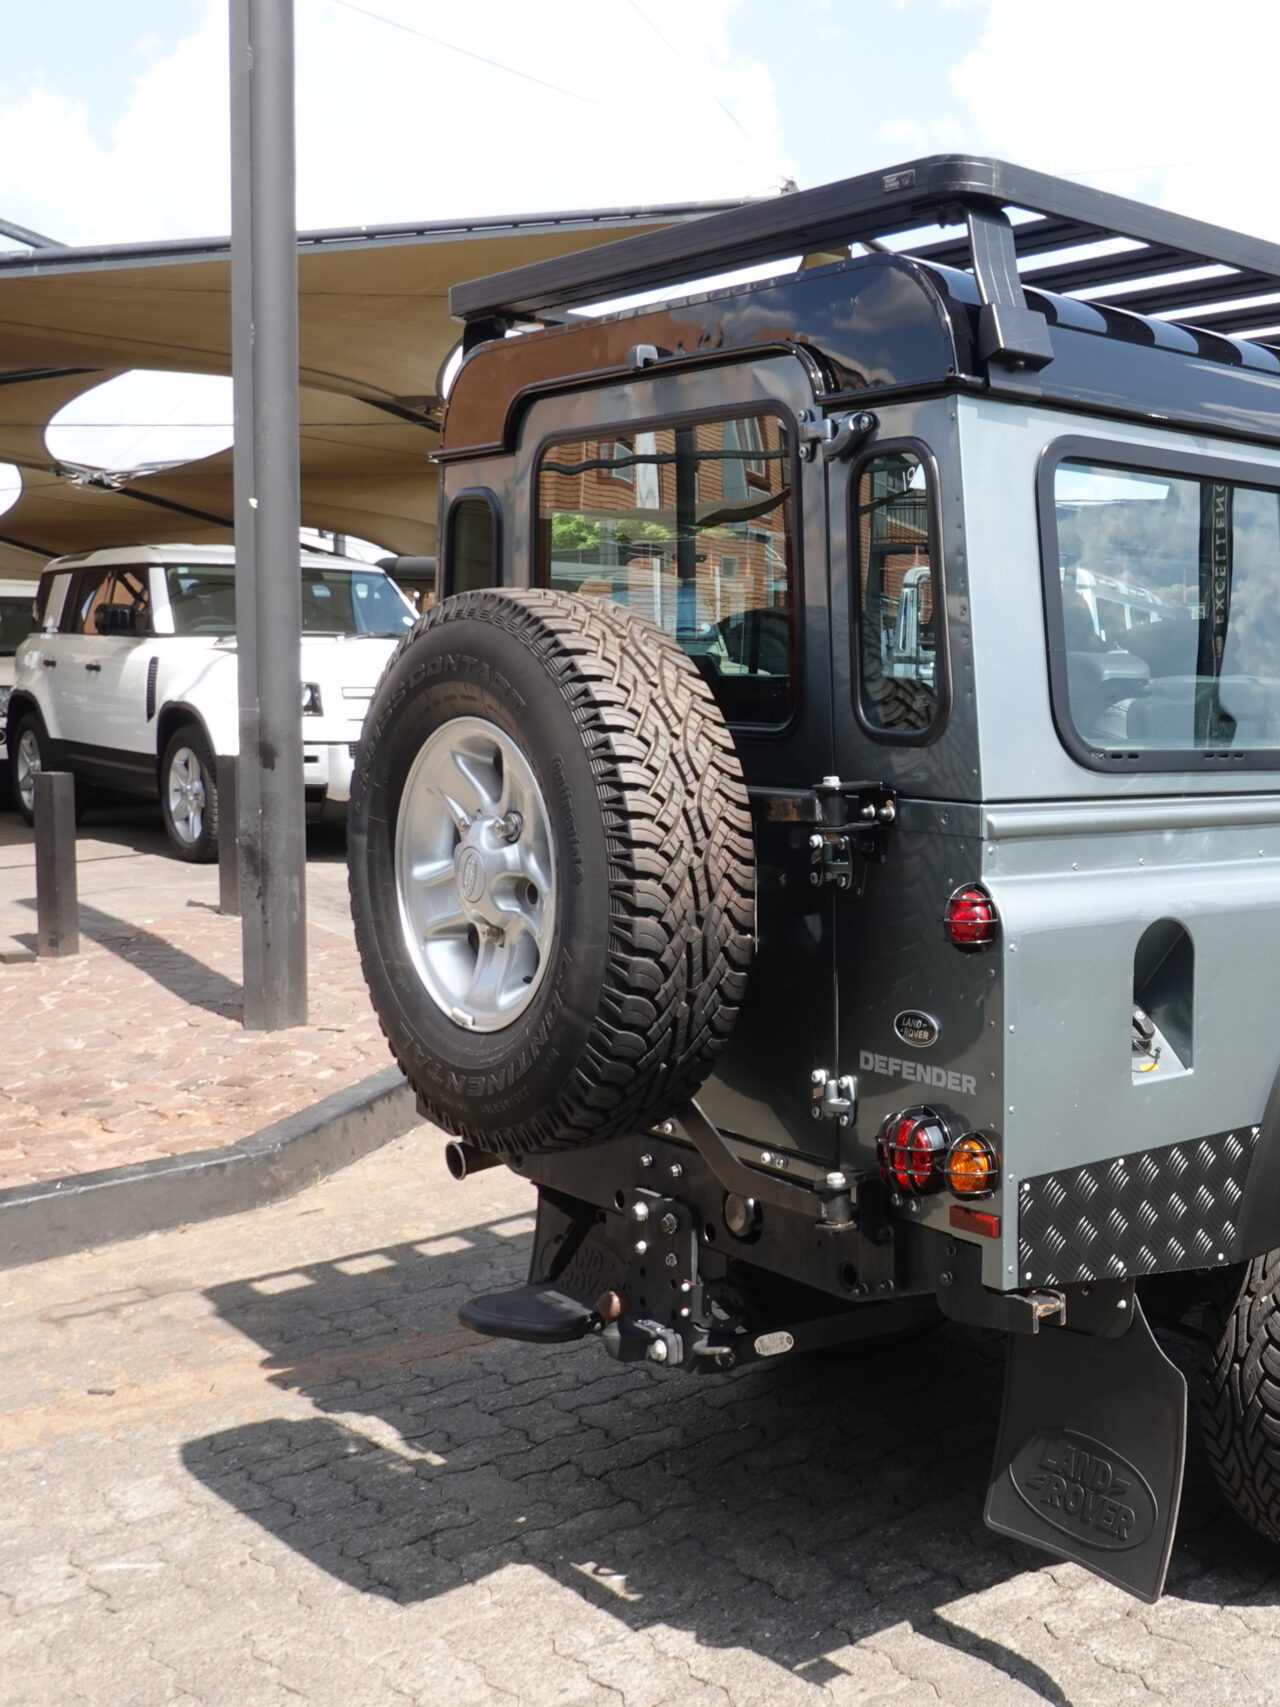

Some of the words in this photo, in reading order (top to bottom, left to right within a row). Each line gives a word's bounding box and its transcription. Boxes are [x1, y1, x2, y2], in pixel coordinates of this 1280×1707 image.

[409, 653, 528, 711] CONTACT
[902, 1017, 923, 1029] LAND
[903, 1028, 929, 1041] ROVER
[859, 1050, 977, 1096] DEFENDER
[1037, 1443, 1113, 1496] LAND
[1040, 1472, 1136, 1541] ROVER
